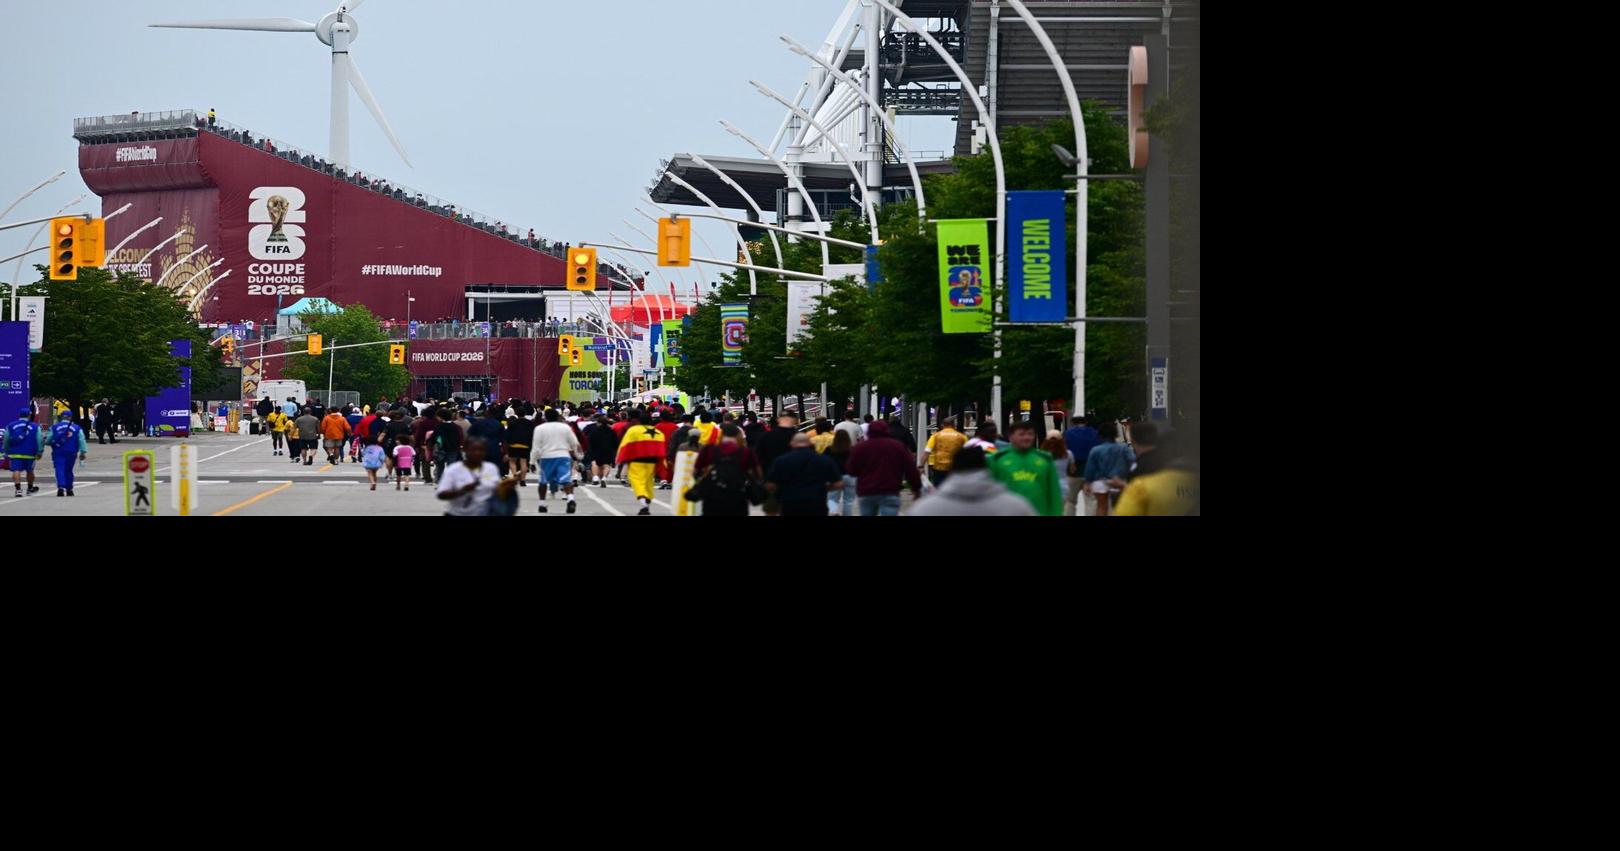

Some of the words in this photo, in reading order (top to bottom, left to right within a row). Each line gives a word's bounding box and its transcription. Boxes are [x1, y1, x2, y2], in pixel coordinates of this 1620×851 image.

[265, 245, 291, 253] FIFA
[1022, 219, 1051, 299] WELCOME
[248, 263, 305, 275] COUPE
[361, 264, 442, 278] #FIFAWorldCup
[248, 276, 264, 284] DU
[265, 276, 305, 284] MONDE
[248, 284, 305, 295] 2026
[412, 352, 425, 362] FIFA
[425, 352, 447, 362] WORLD
[447, 352, 460, 361] CUP
[460, 351, 484, 361] 2026
